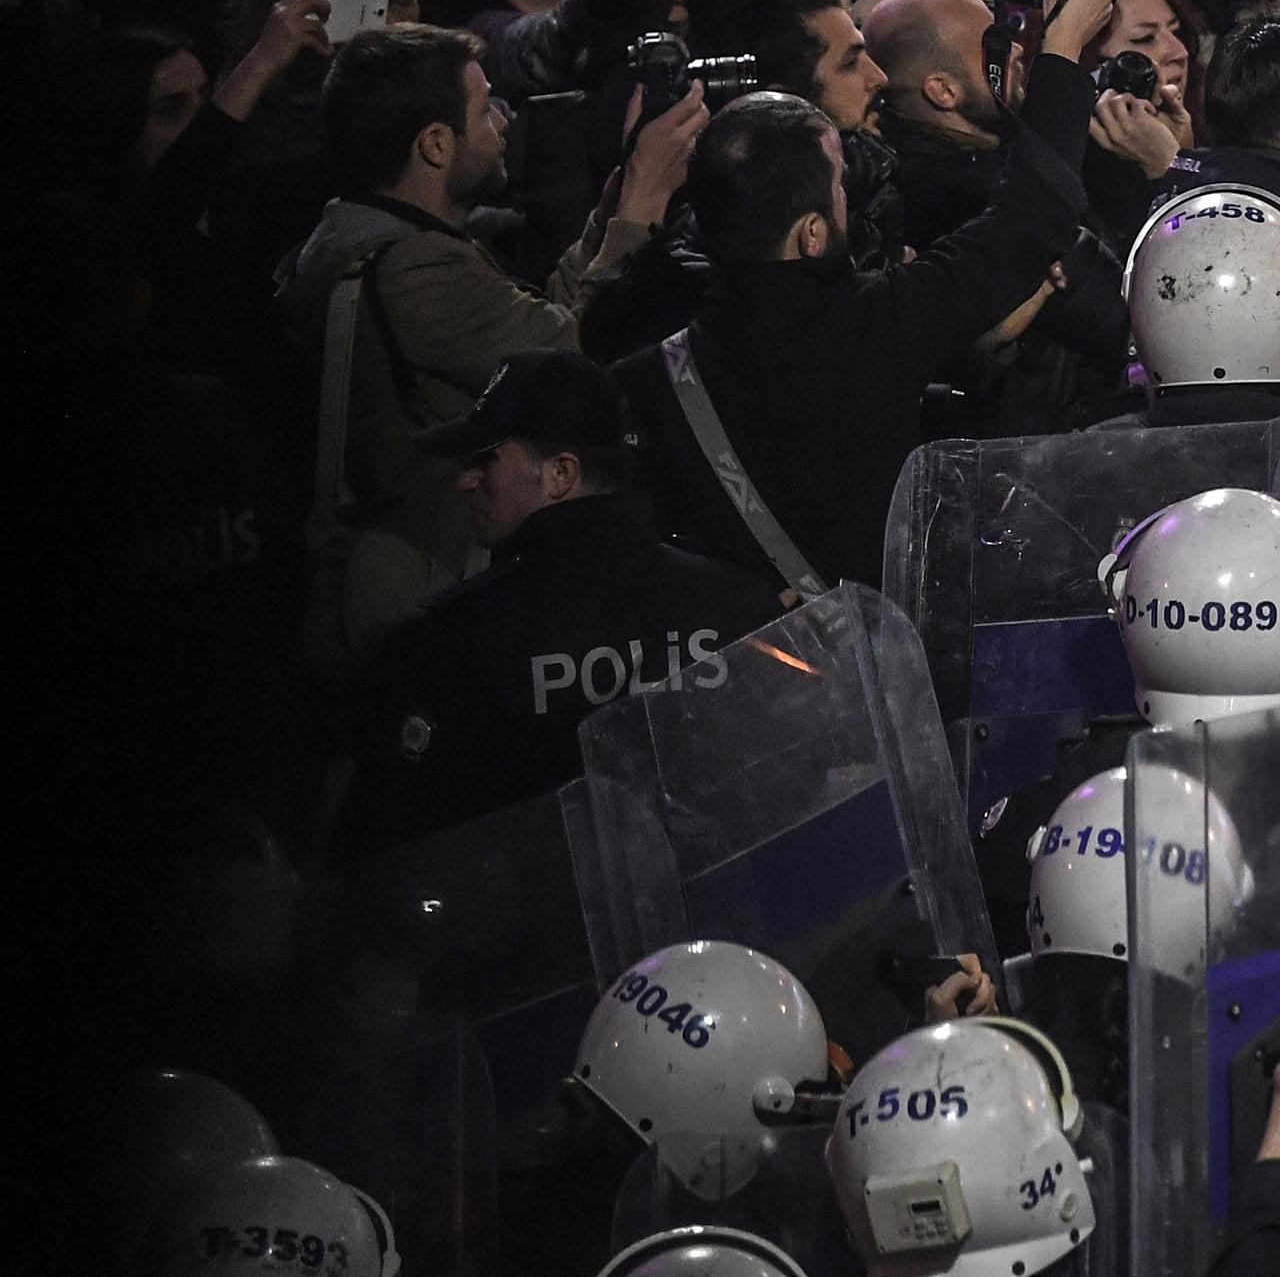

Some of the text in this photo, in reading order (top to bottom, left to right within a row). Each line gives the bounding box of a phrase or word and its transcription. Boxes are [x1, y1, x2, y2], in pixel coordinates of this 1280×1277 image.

[1164, 203, 1266, 231] T-458
[531, 628, 729, 715] POLİS
[846, 1083, 969, 1140] T-505
[1019, 1167, 1058, 1211] 34
